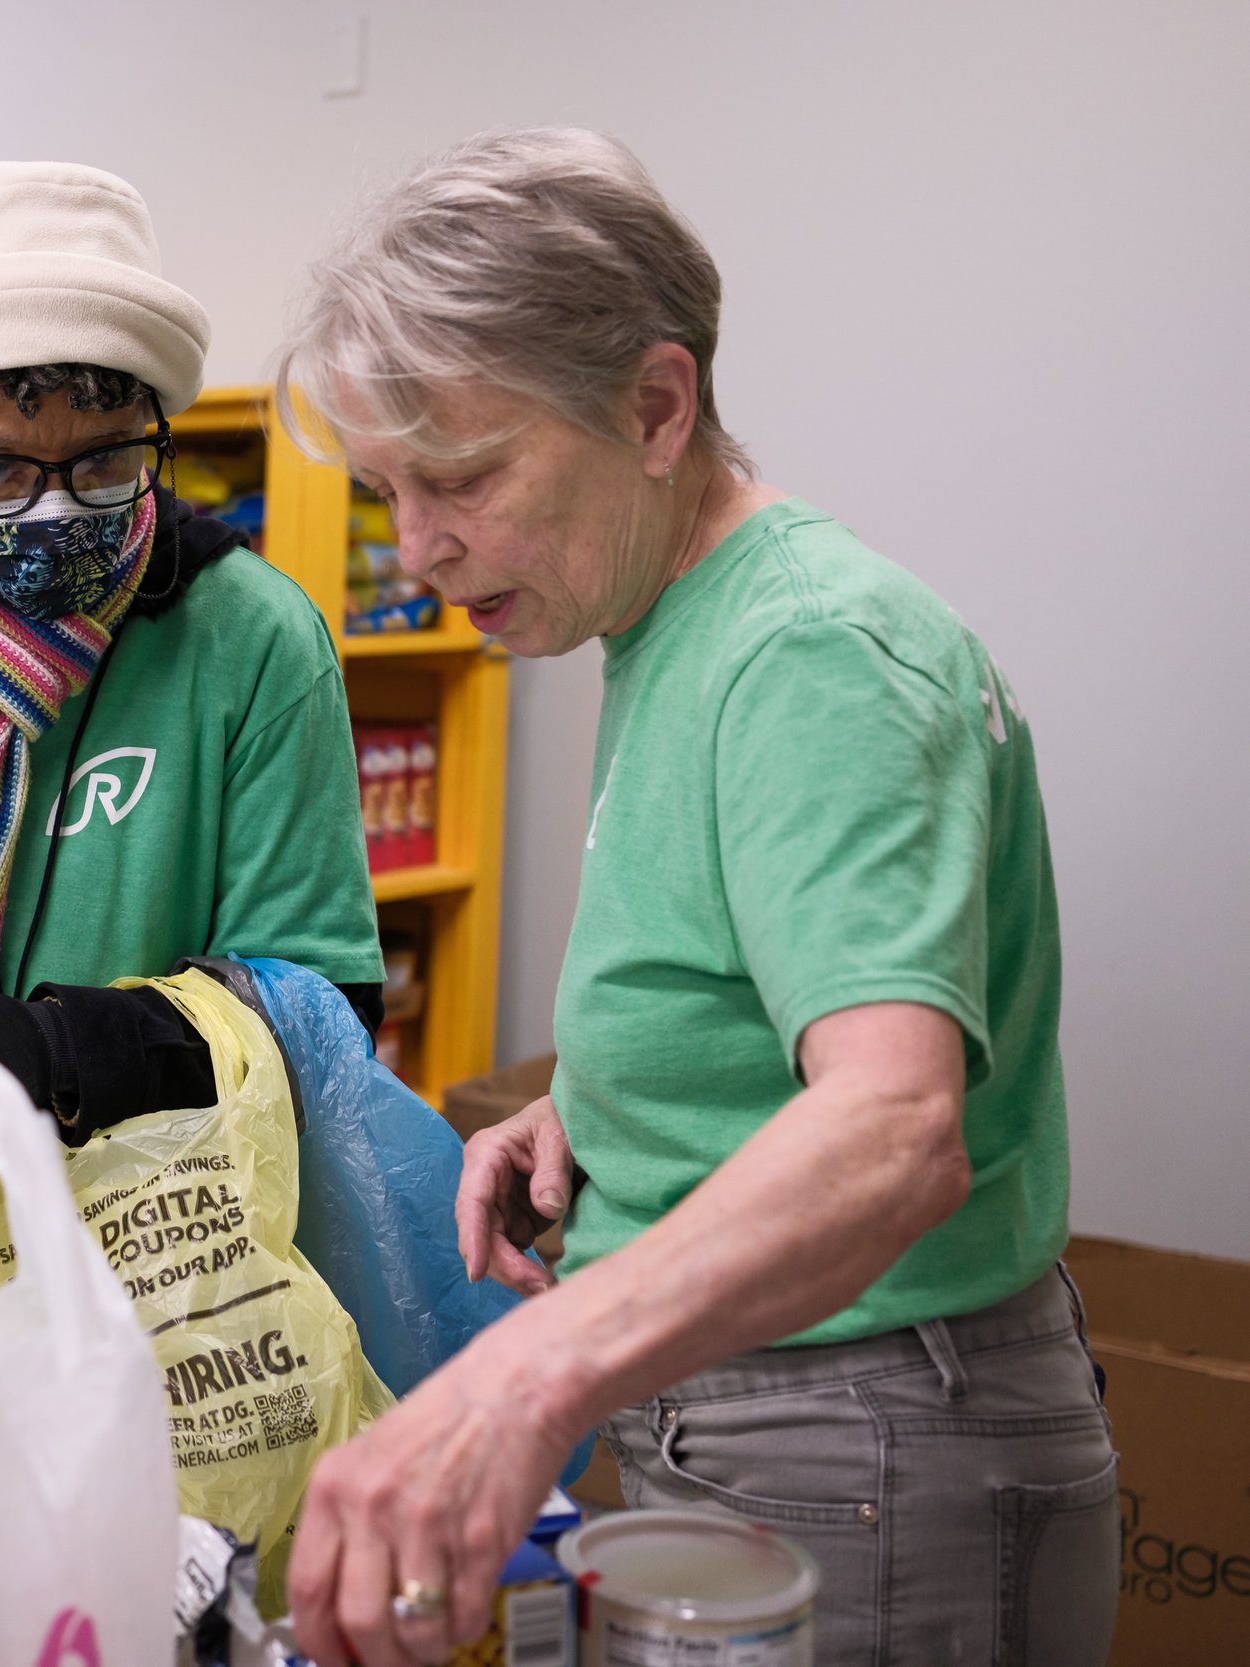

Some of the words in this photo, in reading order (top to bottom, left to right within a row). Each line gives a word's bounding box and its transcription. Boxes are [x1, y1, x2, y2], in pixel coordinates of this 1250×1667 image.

[99, 1184, 243, 1250] DIGITAL
[107, 1206, 245, 1271] COUPONS
[158, 1255, 209, 1288] OUR
[211, 1236, 256, 1274] APP.
[169, 1434, 180, 1449] R
[181, 1433, 214, 1448] VISIT
[217, 1428, 236, 1445] US
[238, 1421, 254, 1439] AT
[199, 1409, 224, 1432] AT
[222, 1400, 255, 1424] DG.
[170, 1439, 261, 1470] ENERAL.COM
